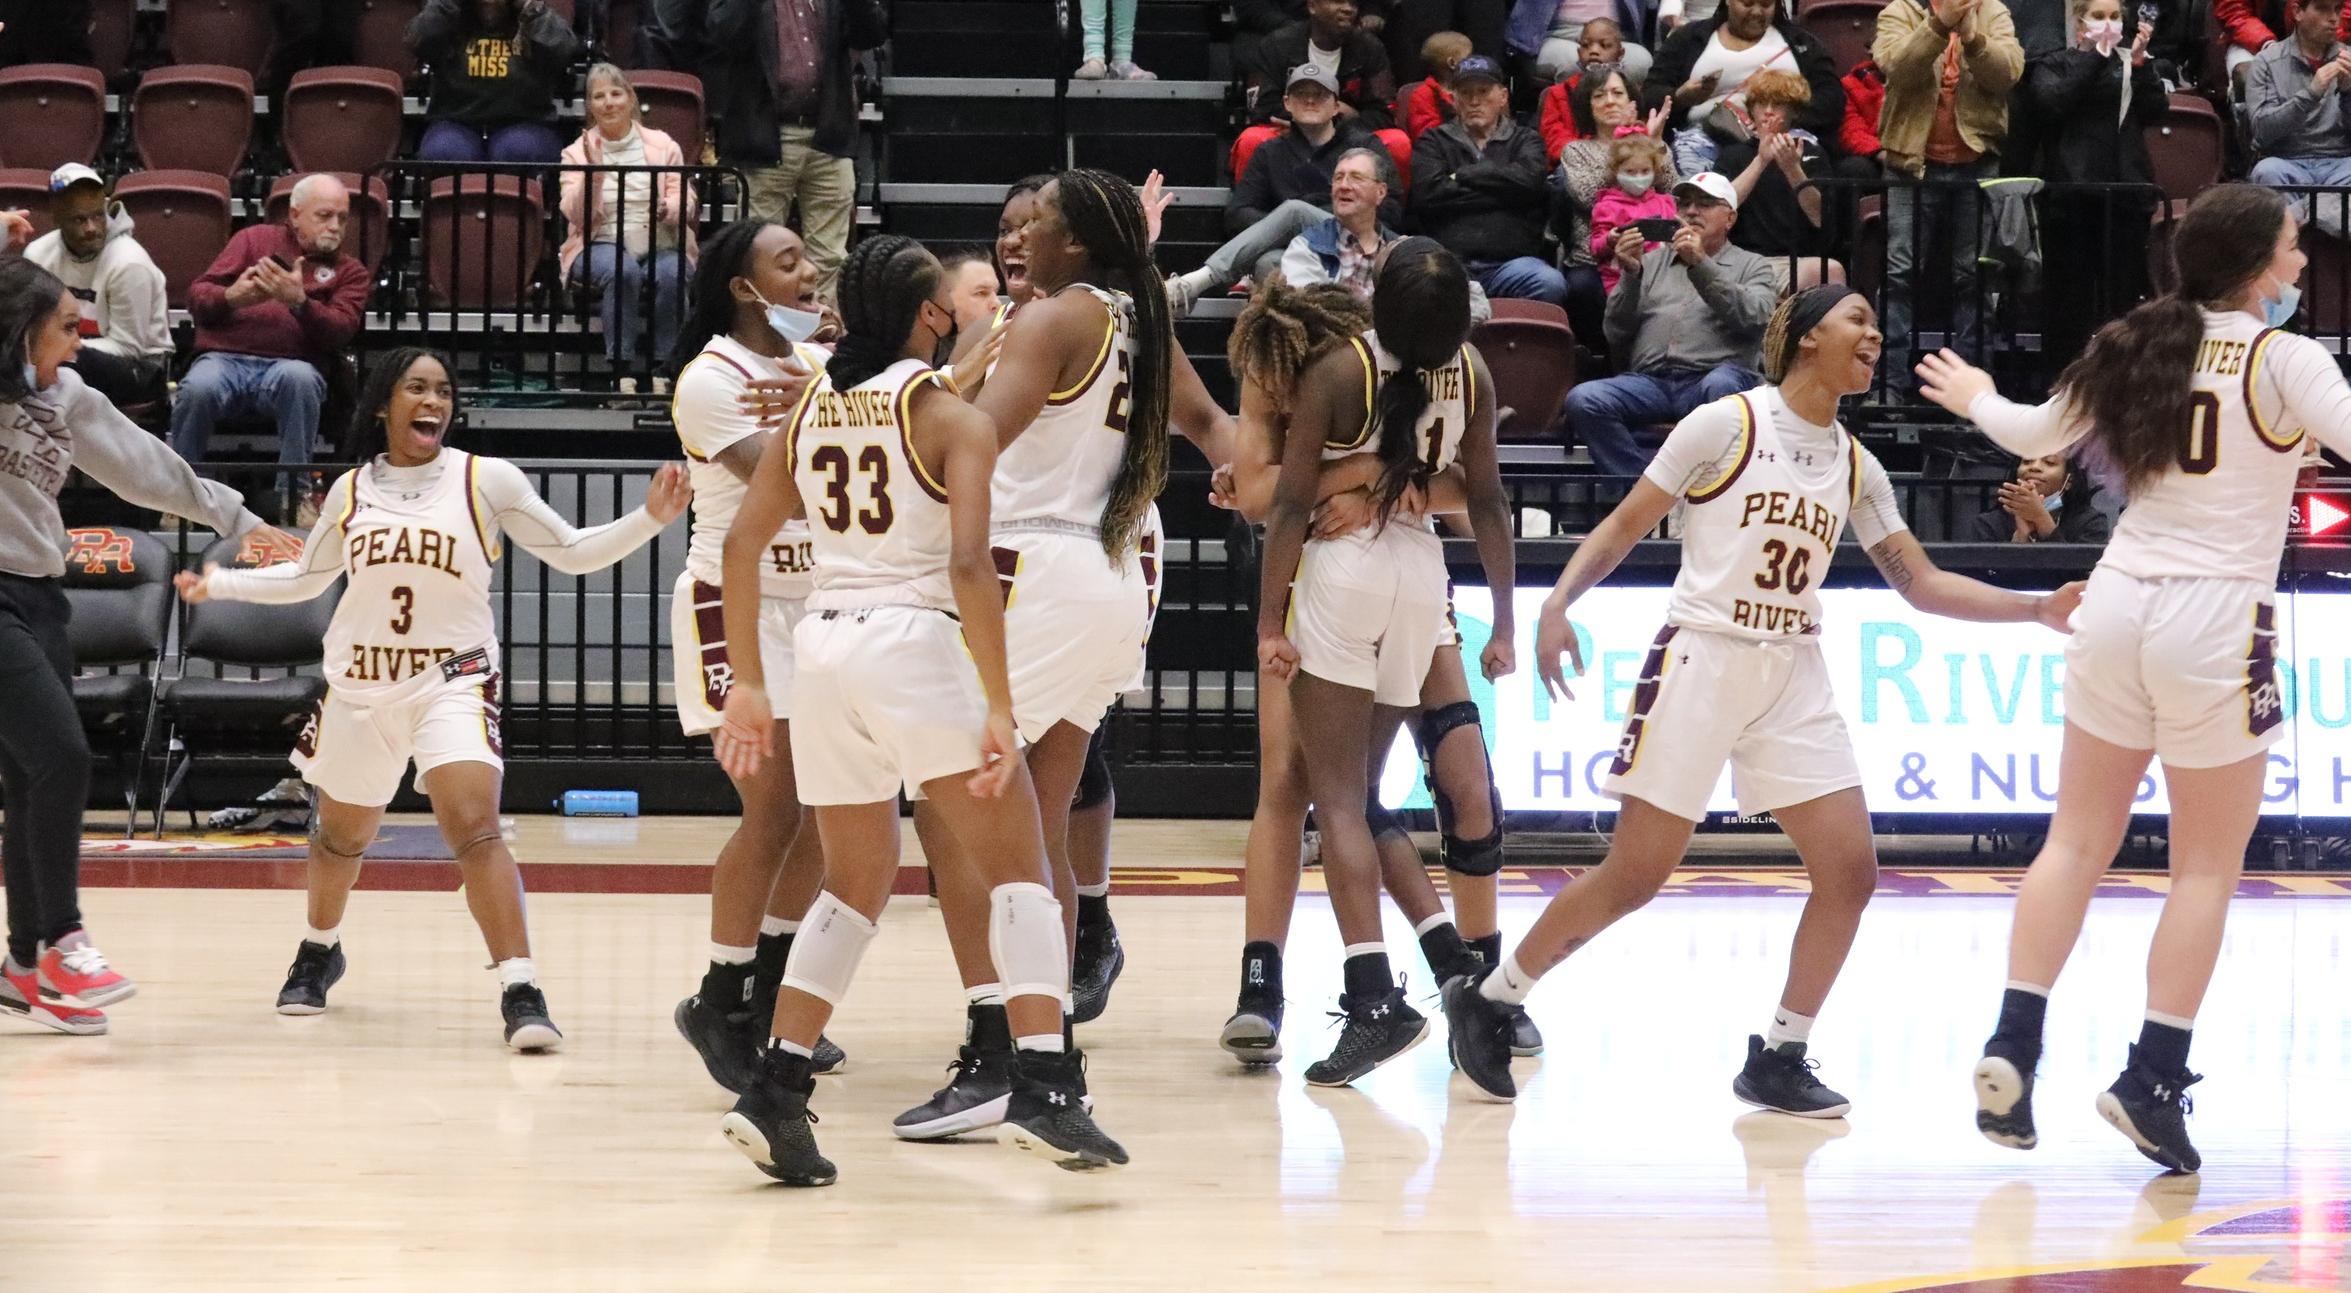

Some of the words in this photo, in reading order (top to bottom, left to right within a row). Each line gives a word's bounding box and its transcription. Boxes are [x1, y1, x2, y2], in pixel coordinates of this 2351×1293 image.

[468, 55, 508, 77] MISS
[811, 445, 894, 534] 33
[1739, 491, 1838, 555] PEARL
[351, 527, 462, 579] PEARL
[1754, 538, 1811, 596] 30
[390, 586, 413, 635] 3
[1895, 752, 1939, 800] &
